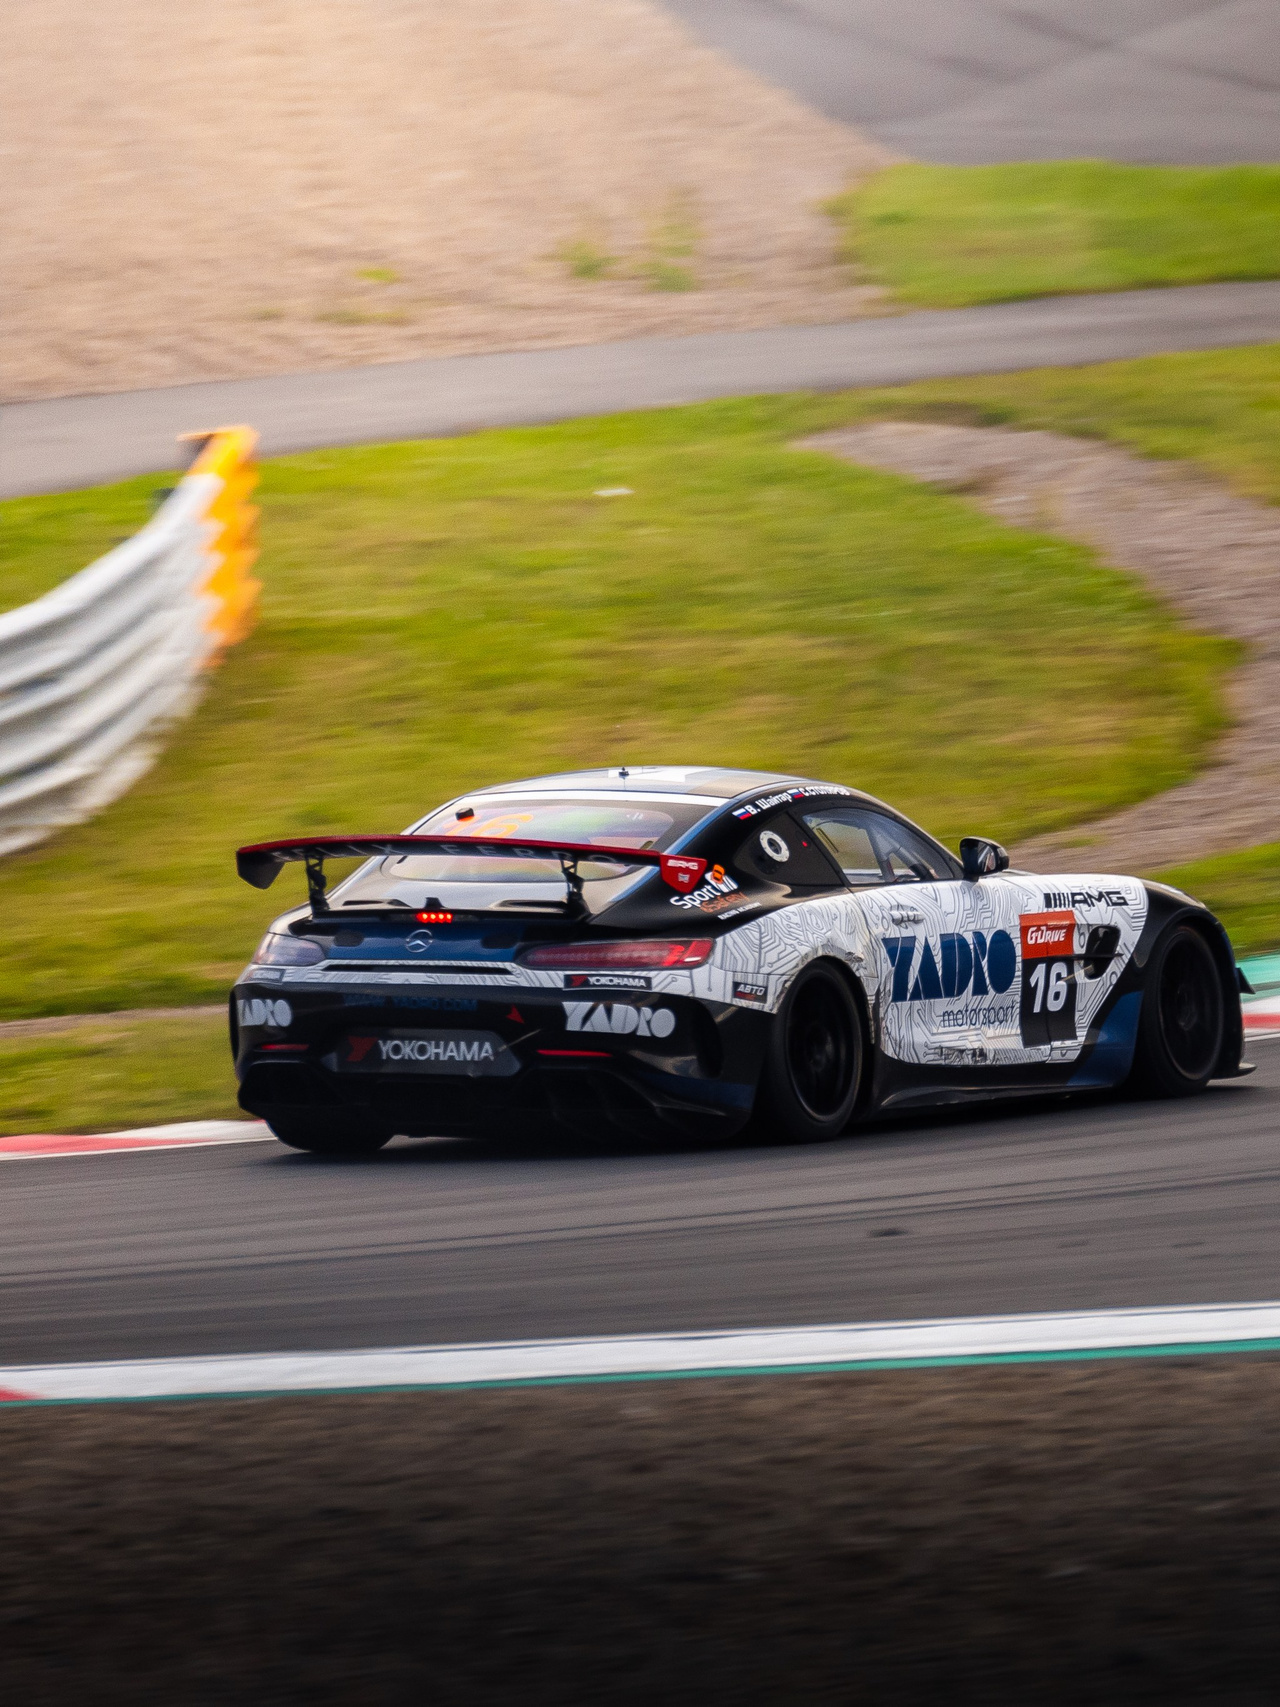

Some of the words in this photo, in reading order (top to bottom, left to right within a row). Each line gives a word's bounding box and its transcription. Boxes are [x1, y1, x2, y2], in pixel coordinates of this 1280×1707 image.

[669, 884, 722, 910] Sport
[1070, 891, 1130, 907] AMG
[881, 929, 1017, 1003] YADRO
[588, 976, 648, 988] YOKOHAMA
[1029, 962, 1069, 1014] 16
[562, 1001, 676, 1039] YADRO
[942, 1001, 1017, 1028] motorsport
[377, 1039, 495, 1061] YOKOHAMA
